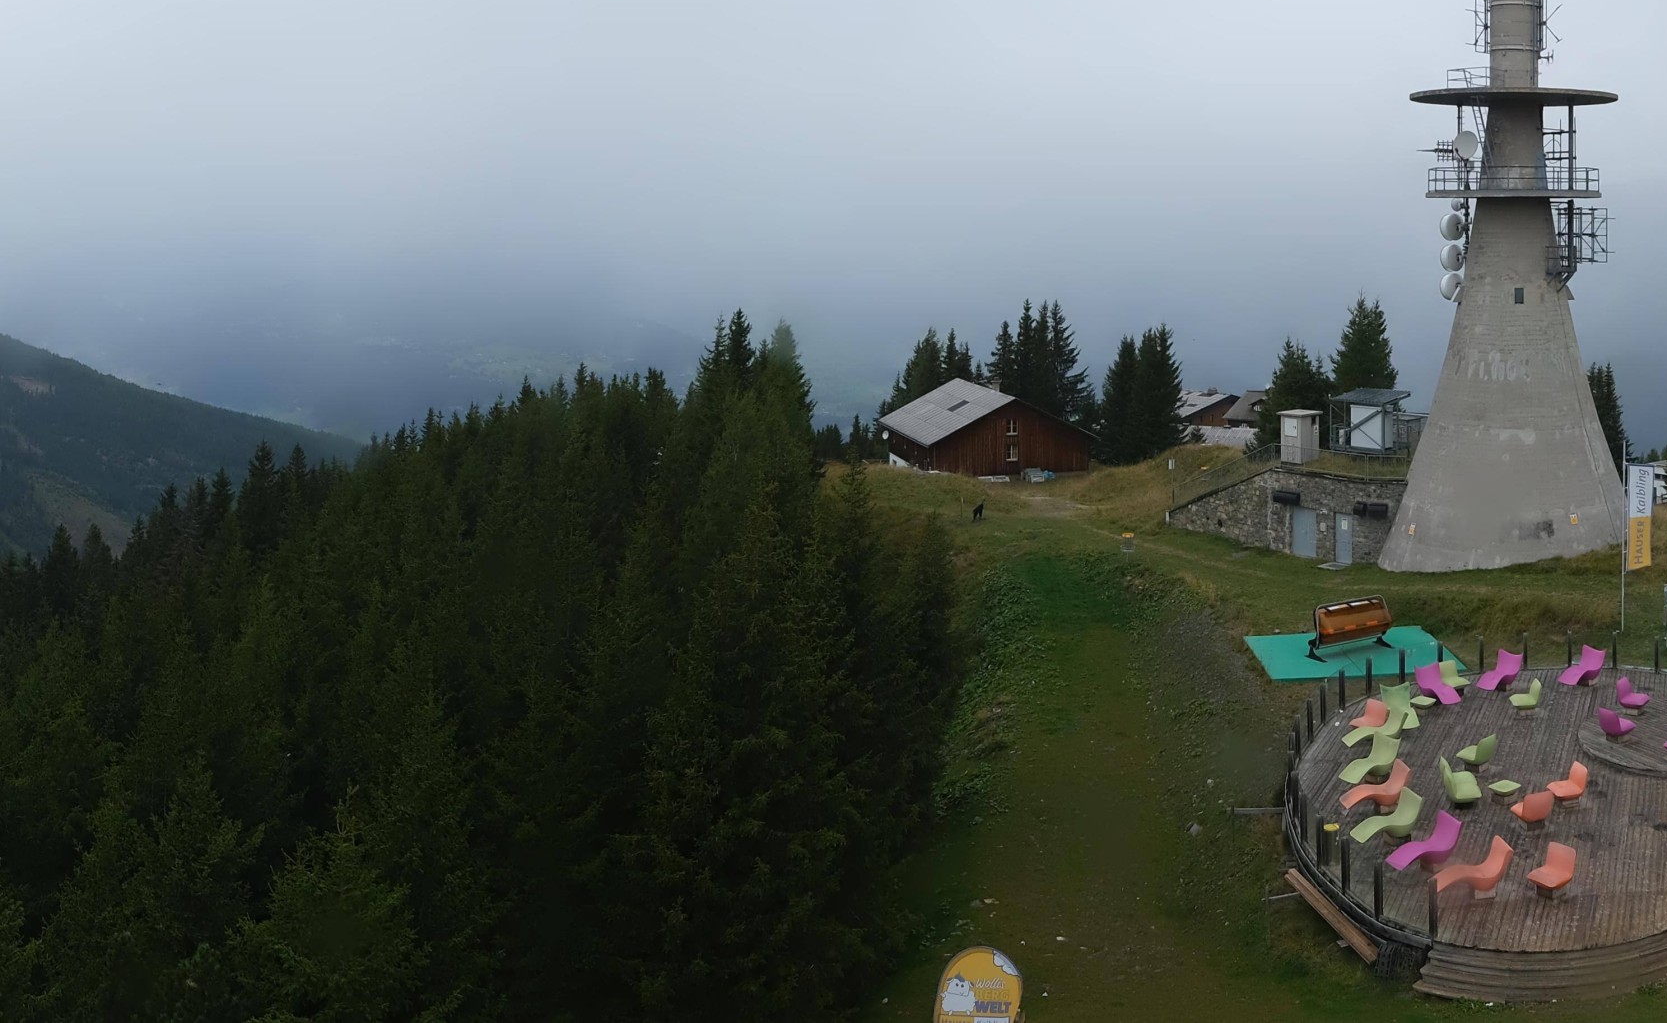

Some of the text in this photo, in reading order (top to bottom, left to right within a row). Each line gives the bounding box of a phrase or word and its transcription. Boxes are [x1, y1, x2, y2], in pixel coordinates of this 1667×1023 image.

[1634, 468, 1649, 565] HAUSER Kaibling
[975, 1001, 1011, 1013] WELT
